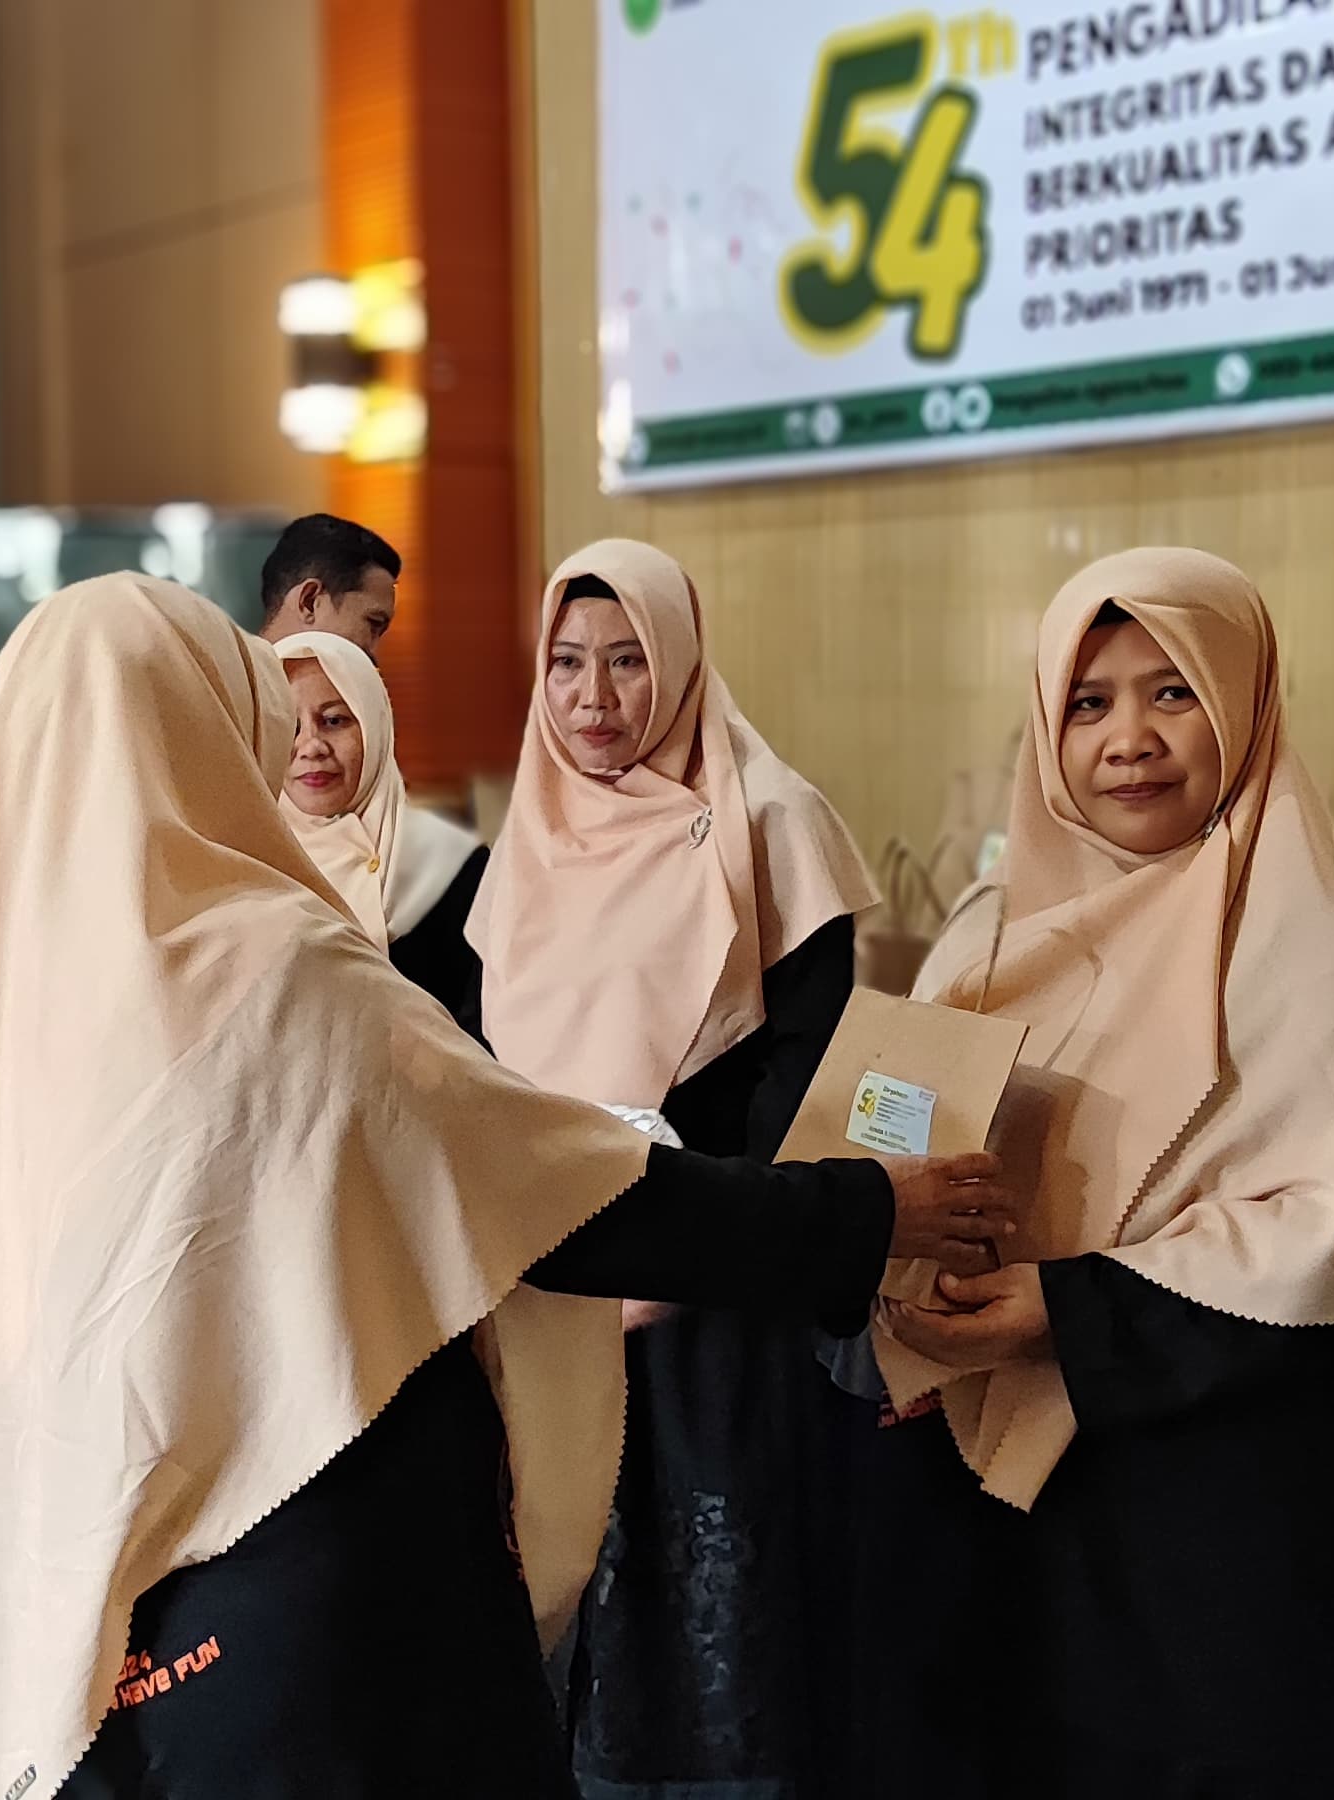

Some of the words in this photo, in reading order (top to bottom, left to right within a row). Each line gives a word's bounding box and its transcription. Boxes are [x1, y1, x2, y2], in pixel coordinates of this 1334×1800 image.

[1023, 57, 1265, 151] INTEGRITAS
[778, 8, 992, 364] 54
[946, 11, 1015, 77] Th
[1025, 117, 1309, 213] BERKUALITAS
[1025, 199, 1242, 275] PRIORITAS
[1022, 296, 1055, 330] 01
[1062, 279, 1133, 326] Juni
[1139, 272, 1209, 312] 1971
[1240, 259, 1278, 298] 01
[173, 1635, 221, 1682] FUN
